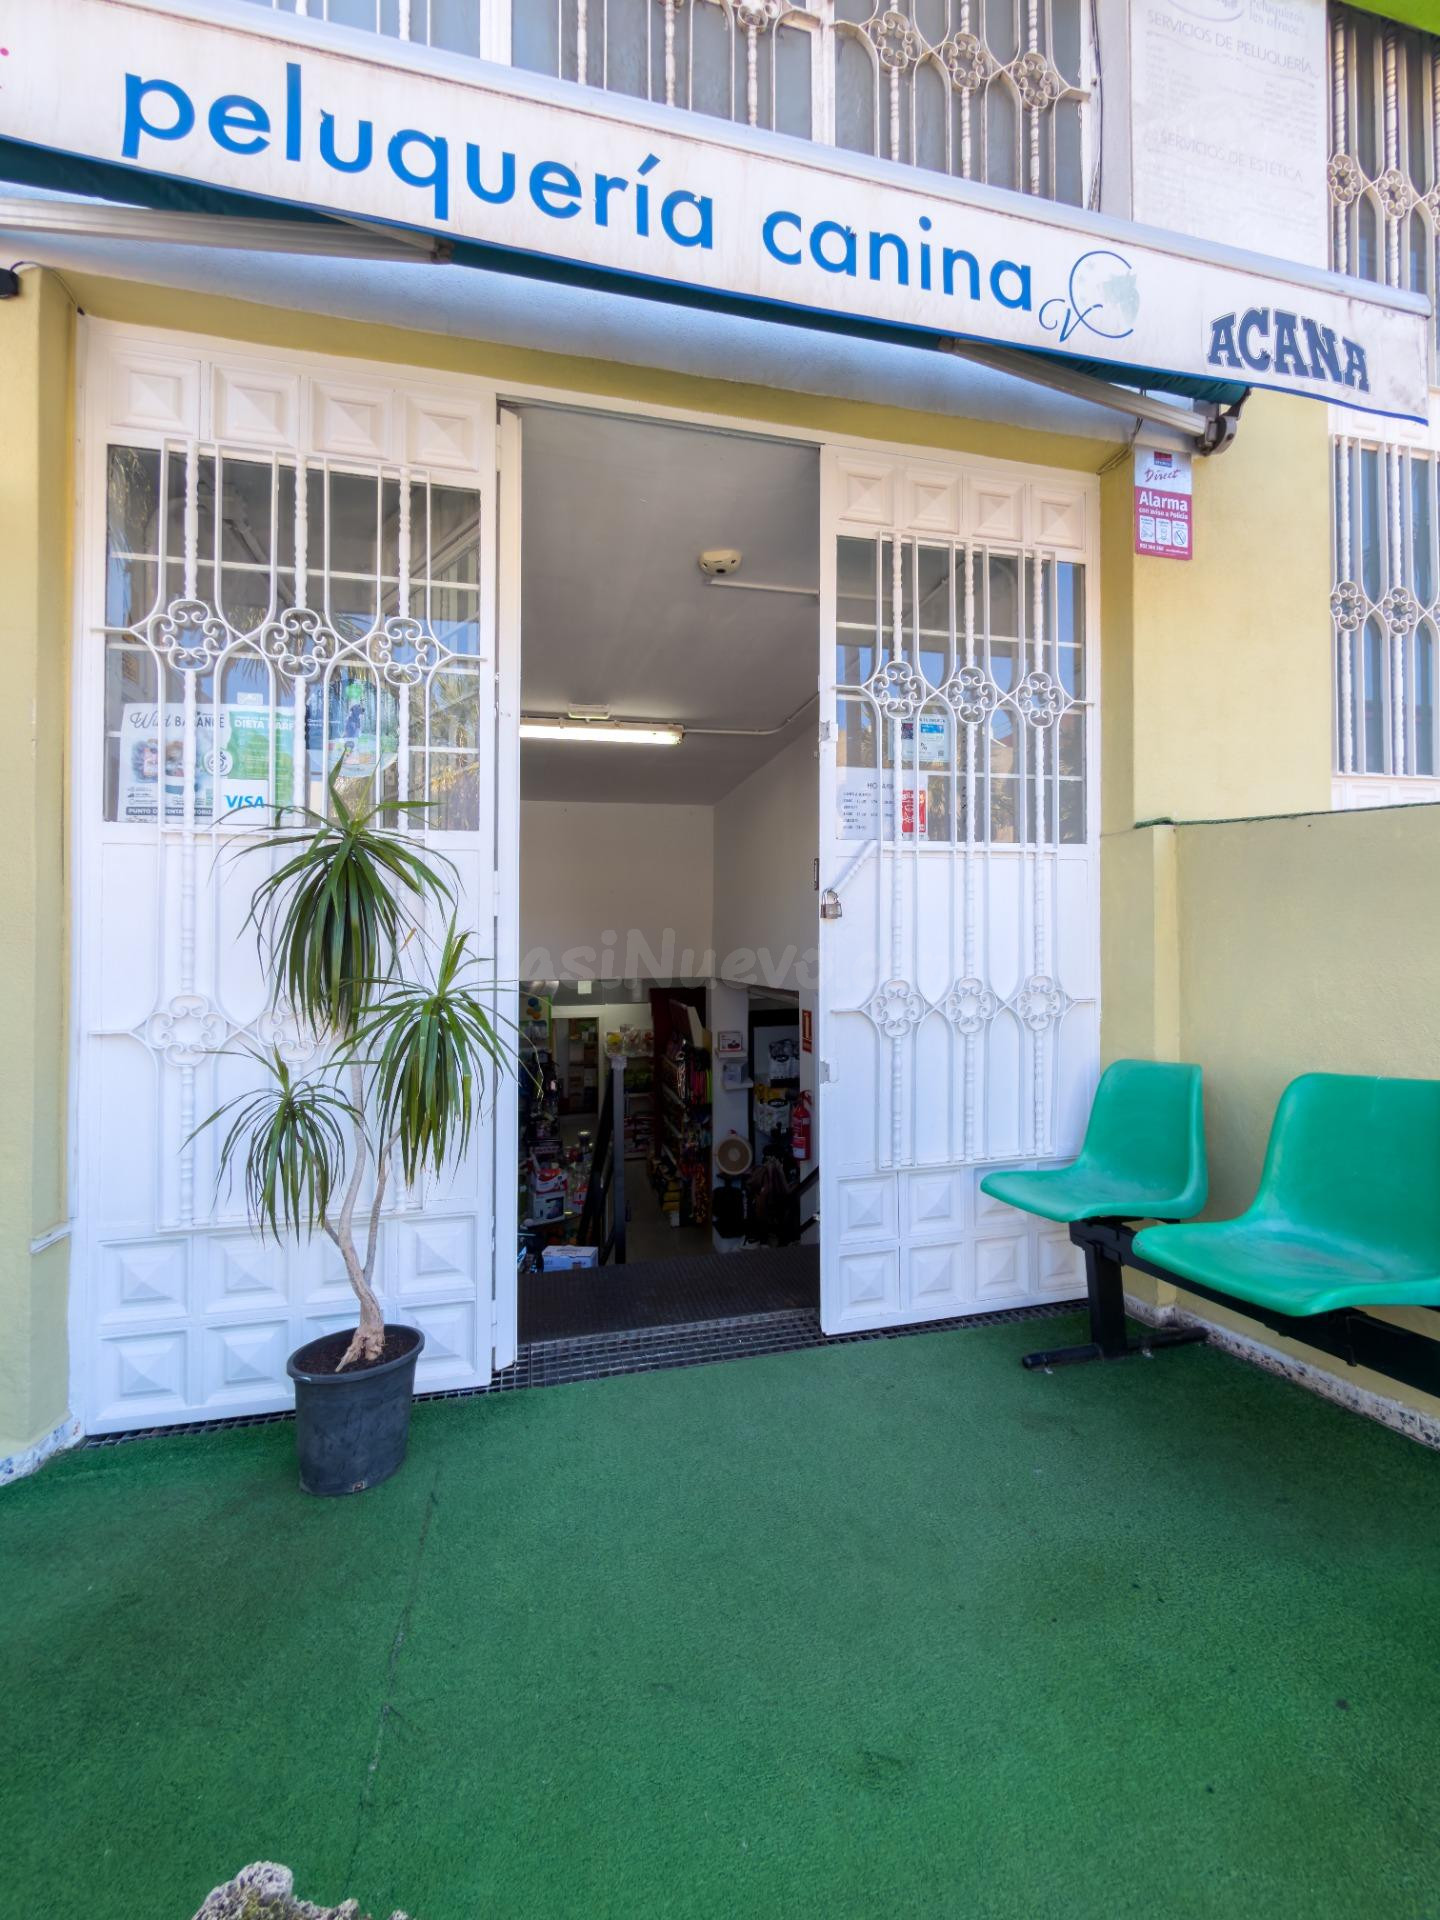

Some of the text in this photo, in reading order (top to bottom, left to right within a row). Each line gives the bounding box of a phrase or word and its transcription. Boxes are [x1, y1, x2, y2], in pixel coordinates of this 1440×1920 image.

[1146, 9, 1212, 44] SERVICIOS
[1215, 32, 1233, 50] DE
[1159, 128, 1225, 161] SERVICIOS
[1228, 151, 1245, 168] DE
[122, 62, 1032, 311] peluquería canina
[1207, 306, 1371, 393] ACANA
[1139, 491, 1188, 512] Alarma
[234, 719, 265, 729] DIETA
[225, 795, 264, 808] VISA
